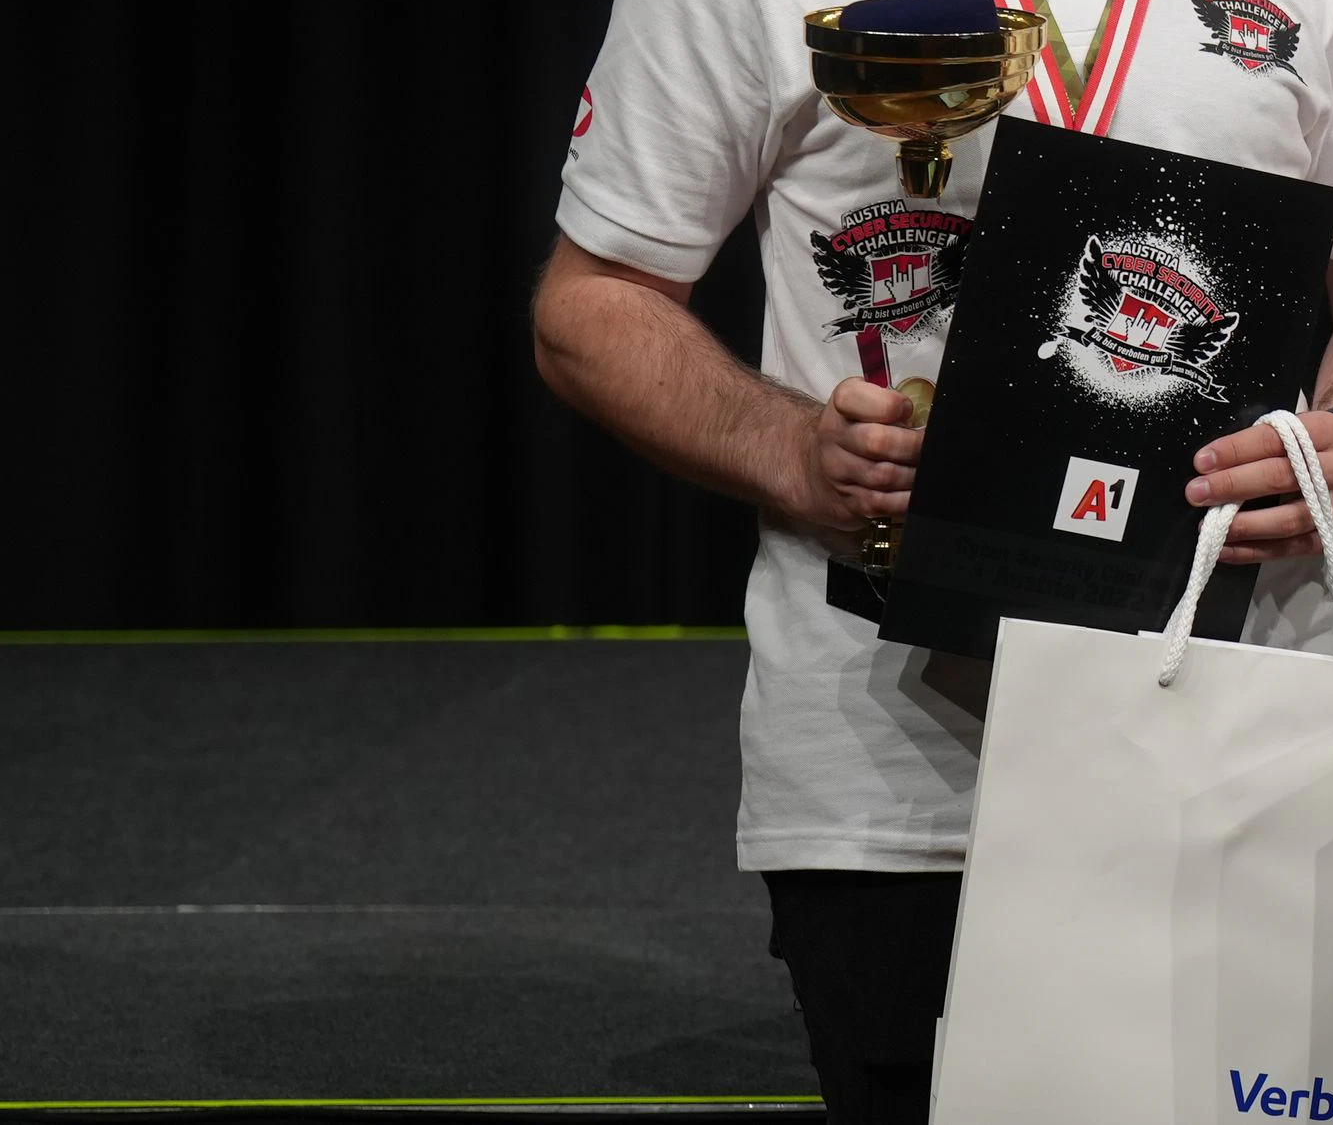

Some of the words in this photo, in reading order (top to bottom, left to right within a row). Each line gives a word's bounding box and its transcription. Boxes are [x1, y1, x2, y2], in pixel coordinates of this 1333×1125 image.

[1219, 1, 1283, 28] CHALLENGE
[844, 200, 906, 227] AUSTRIA
[831, 217, 888, 252] CYBER
[889, 212, 974, 235] SECURITY
[857, 228, 948, 256] CHALLENGE
[1122, 241, 1180, 271] AUSTRIA
[861, 309, 873, 320] Du
[874, 307, 890, 318] bist
[891, 299, 925, 317] verboten
[926, 288, 942, 306] gut?
[1101, 254, 1156, 276] CYBER
[1156, 265, 1225, 324] SECURITY
[1119, 271, 1201, 322] CHALLENGE
[1091, 329, 1102, 342] Du
[1101, 334, 1117, 351] bist
[1117, 342, 1150, 362] verboten
[1150, 353, 1169, 365] gut?
[1070, 478, 1125, 522] A1
